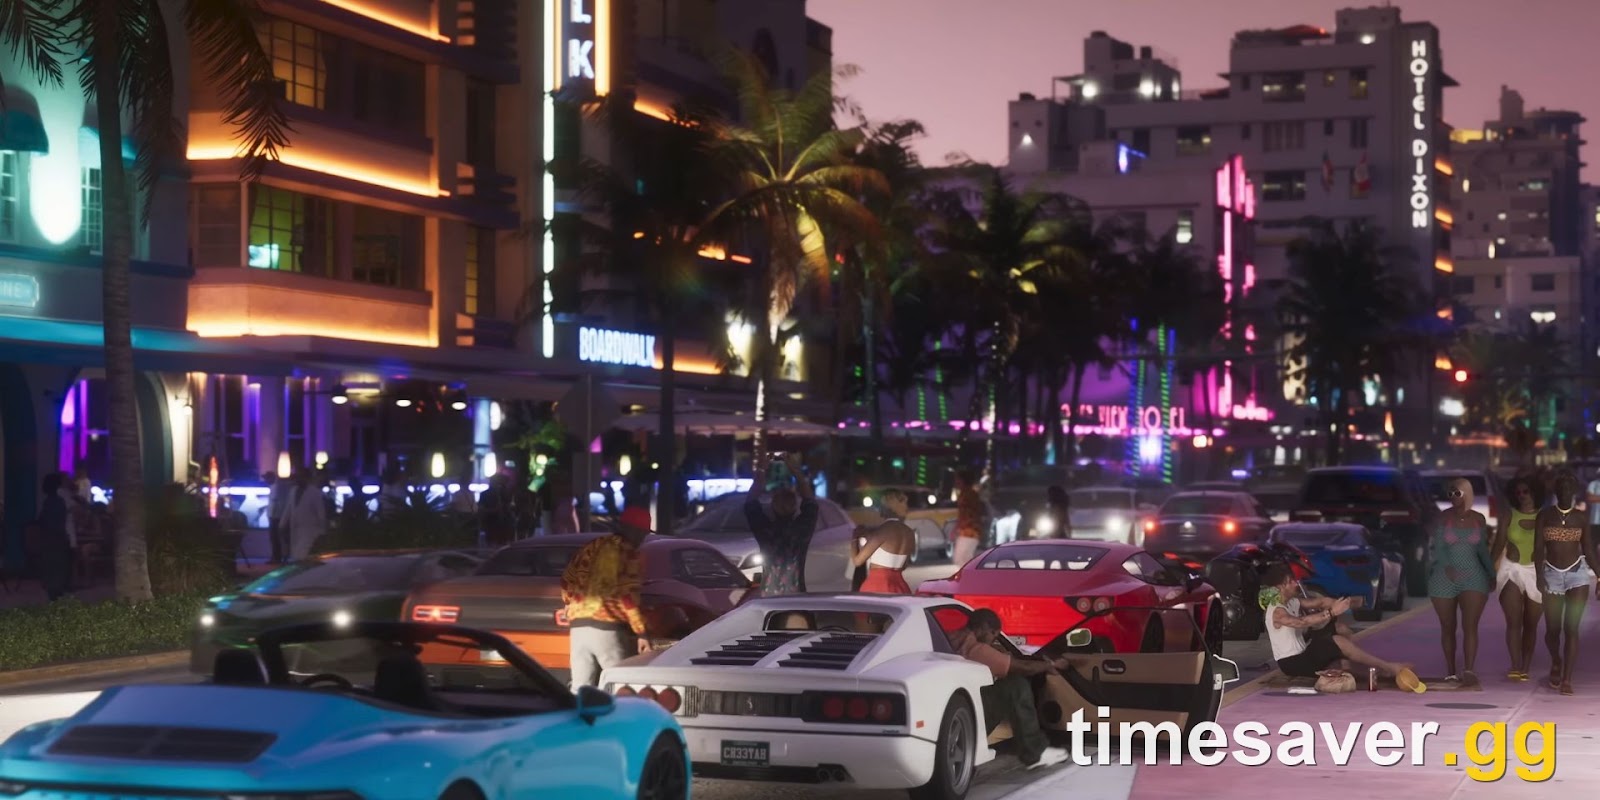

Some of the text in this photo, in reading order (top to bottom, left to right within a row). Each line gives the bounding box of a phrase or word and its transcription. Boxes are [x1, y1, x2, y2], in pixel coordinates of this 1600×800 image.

[1410, 40, 1429, 228] HOTEL DIXON
[579, 326, 656, 368] BOARDWALK
